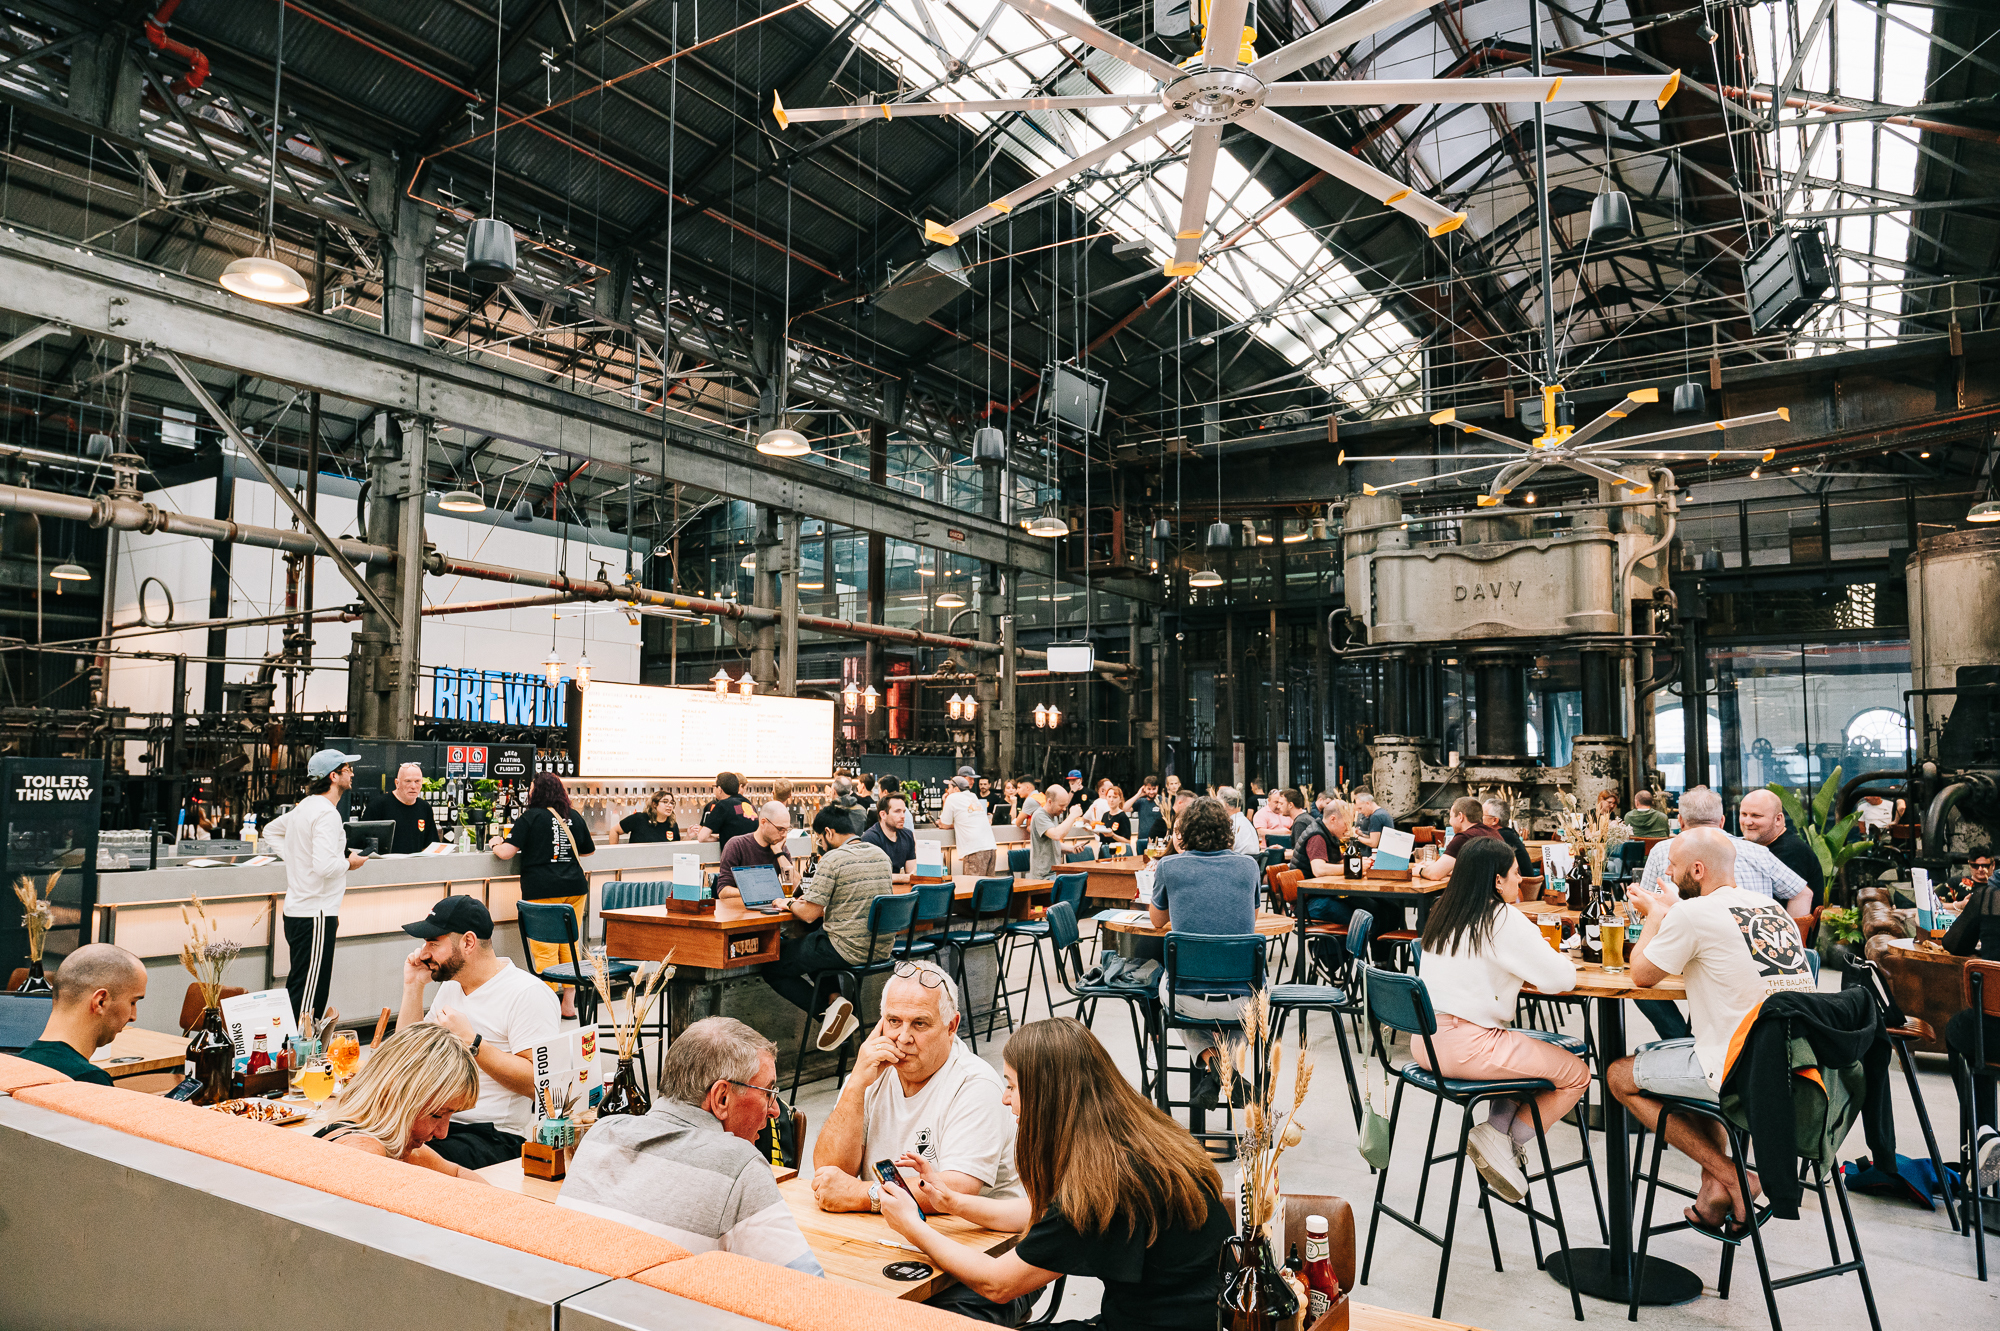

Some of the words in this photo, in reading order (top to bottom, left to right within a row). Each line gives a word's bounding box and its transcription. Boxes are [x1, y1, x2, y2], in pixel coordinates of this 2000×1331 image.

[1182, 91, 1196, 100] BIG
[1199, 85, 1218, 93] ASS
[1222, 85, 1246, 95] FANS
[1454, 580, 1522, 602] DAVY
[22, 775, 89, 788] TOILETS
[15, 788, 54, 801] THIS
[56, 788, 94, 801] WAY
[1767, 979, 1785, 987] THE
[231, 1022, 246, 1056] DRINKS
[536, 1046, 549, 1076] FOOD
